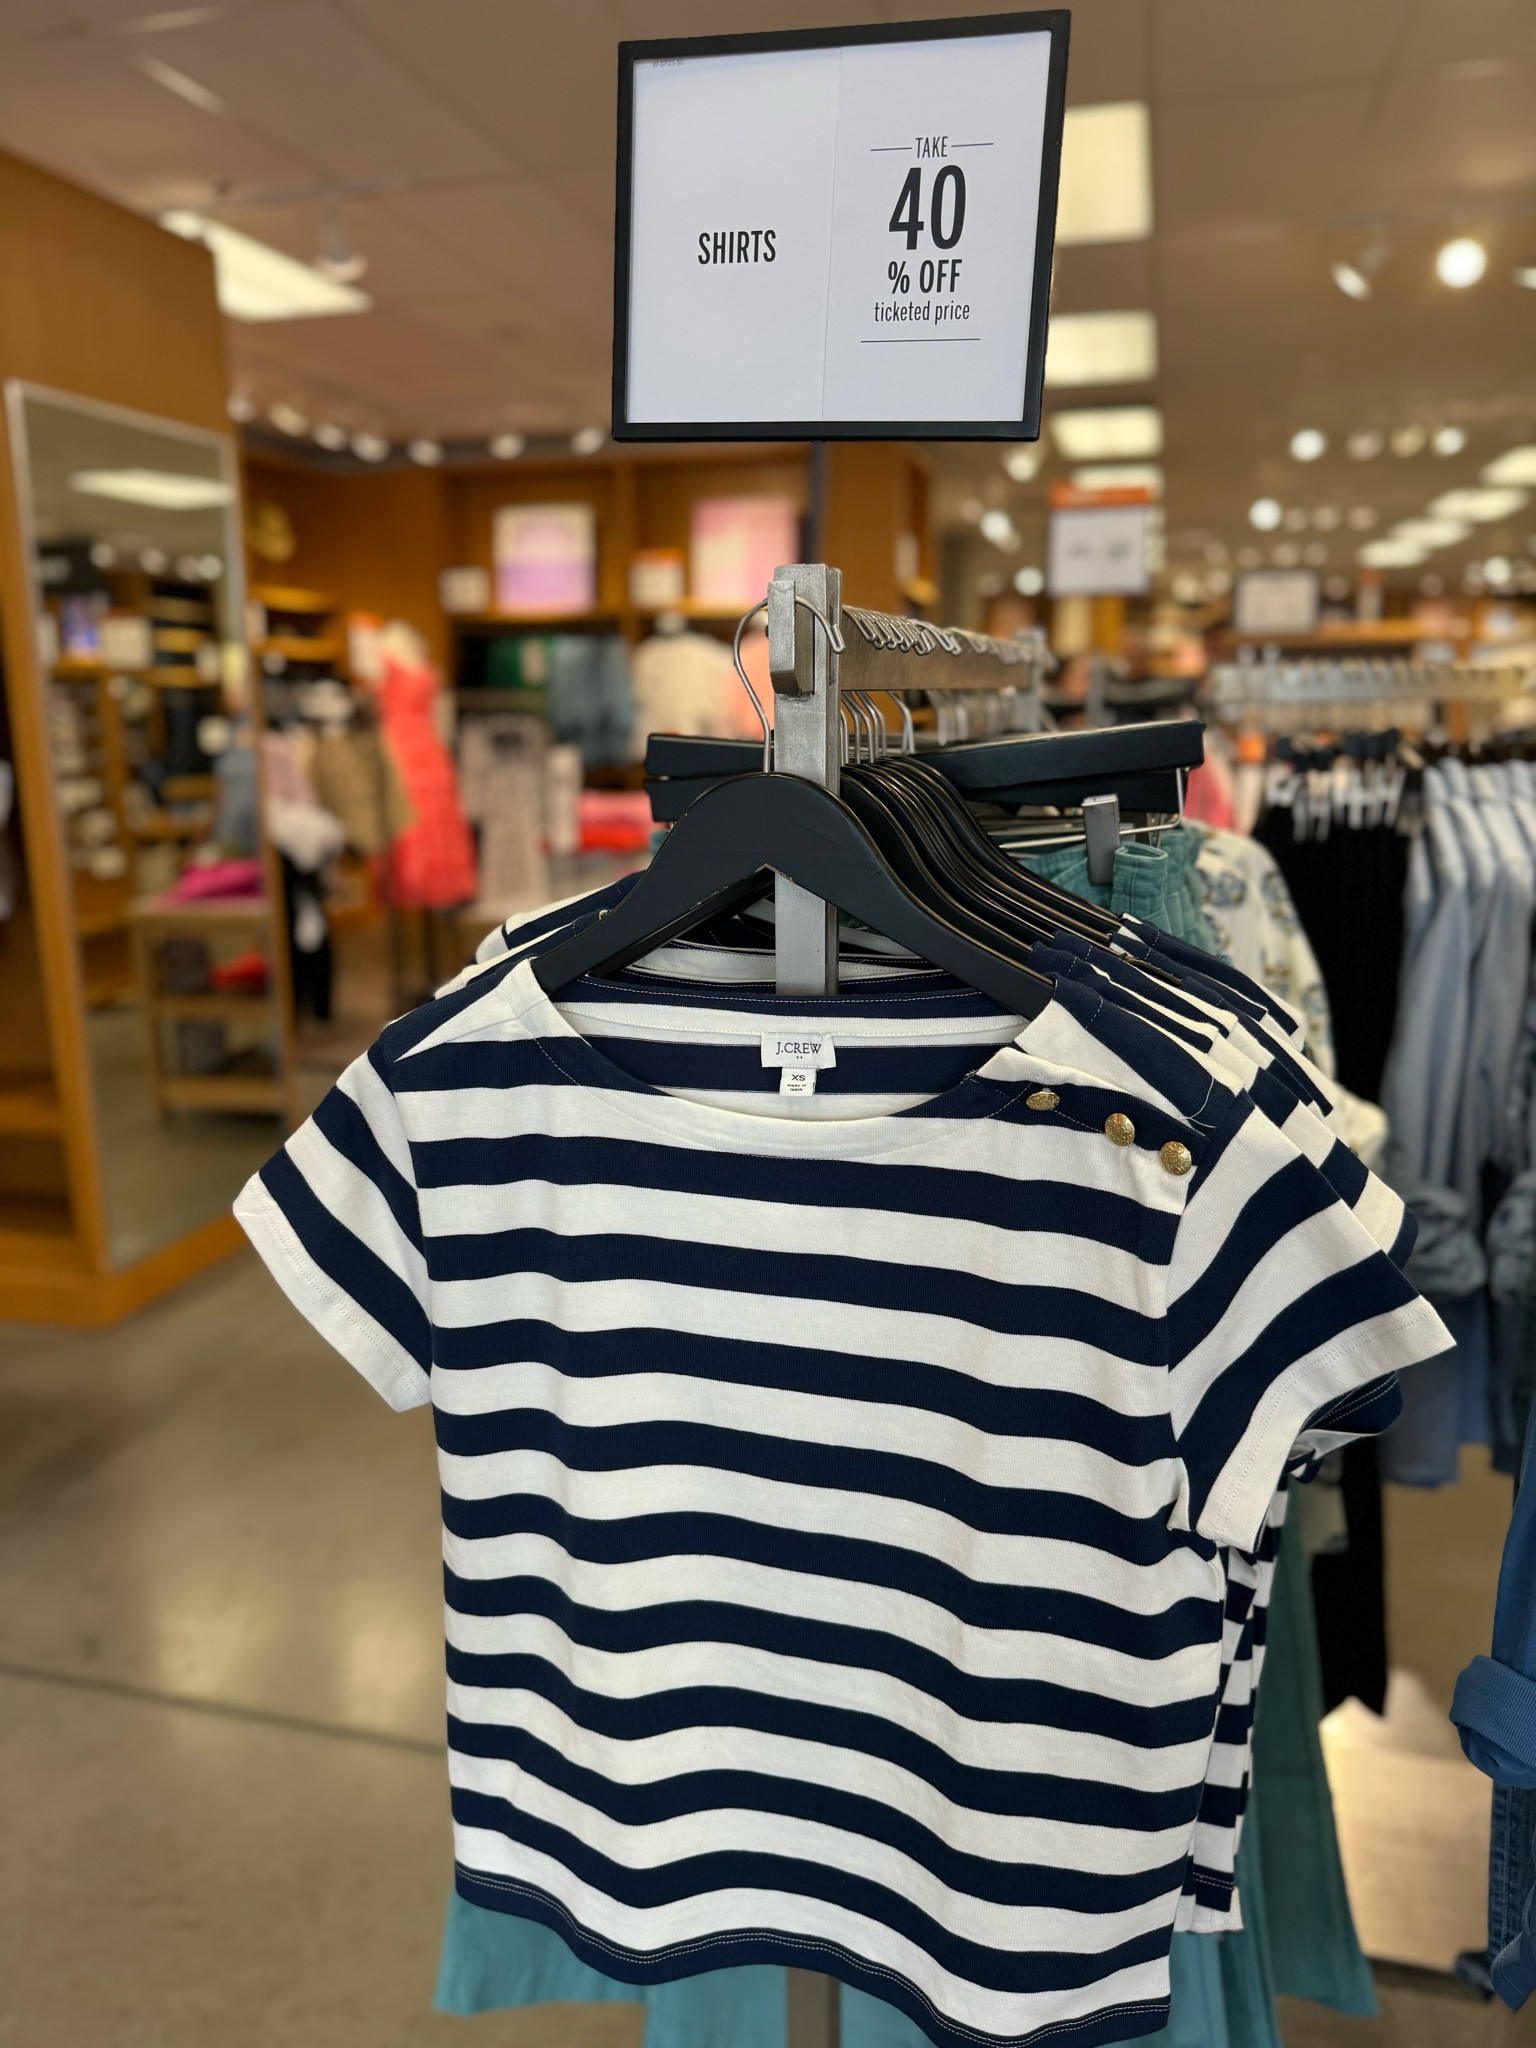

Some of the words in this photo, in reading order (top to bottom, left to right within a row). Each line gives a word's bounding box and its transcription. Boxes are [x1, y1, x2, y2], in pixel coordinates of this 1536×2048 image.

[916, 136, 948, 158] TAKE
[889, 165, 966, 250] 40
[698, 230, 776, 264] SHIRTS
[888, 261, 910, 294] %
[920, 259, 962, 293] OFF
[875, 301, 930, 321] ticketed
[935, 300, 969, 325] price
[776, 1042, 821, 1055] J.CREW
